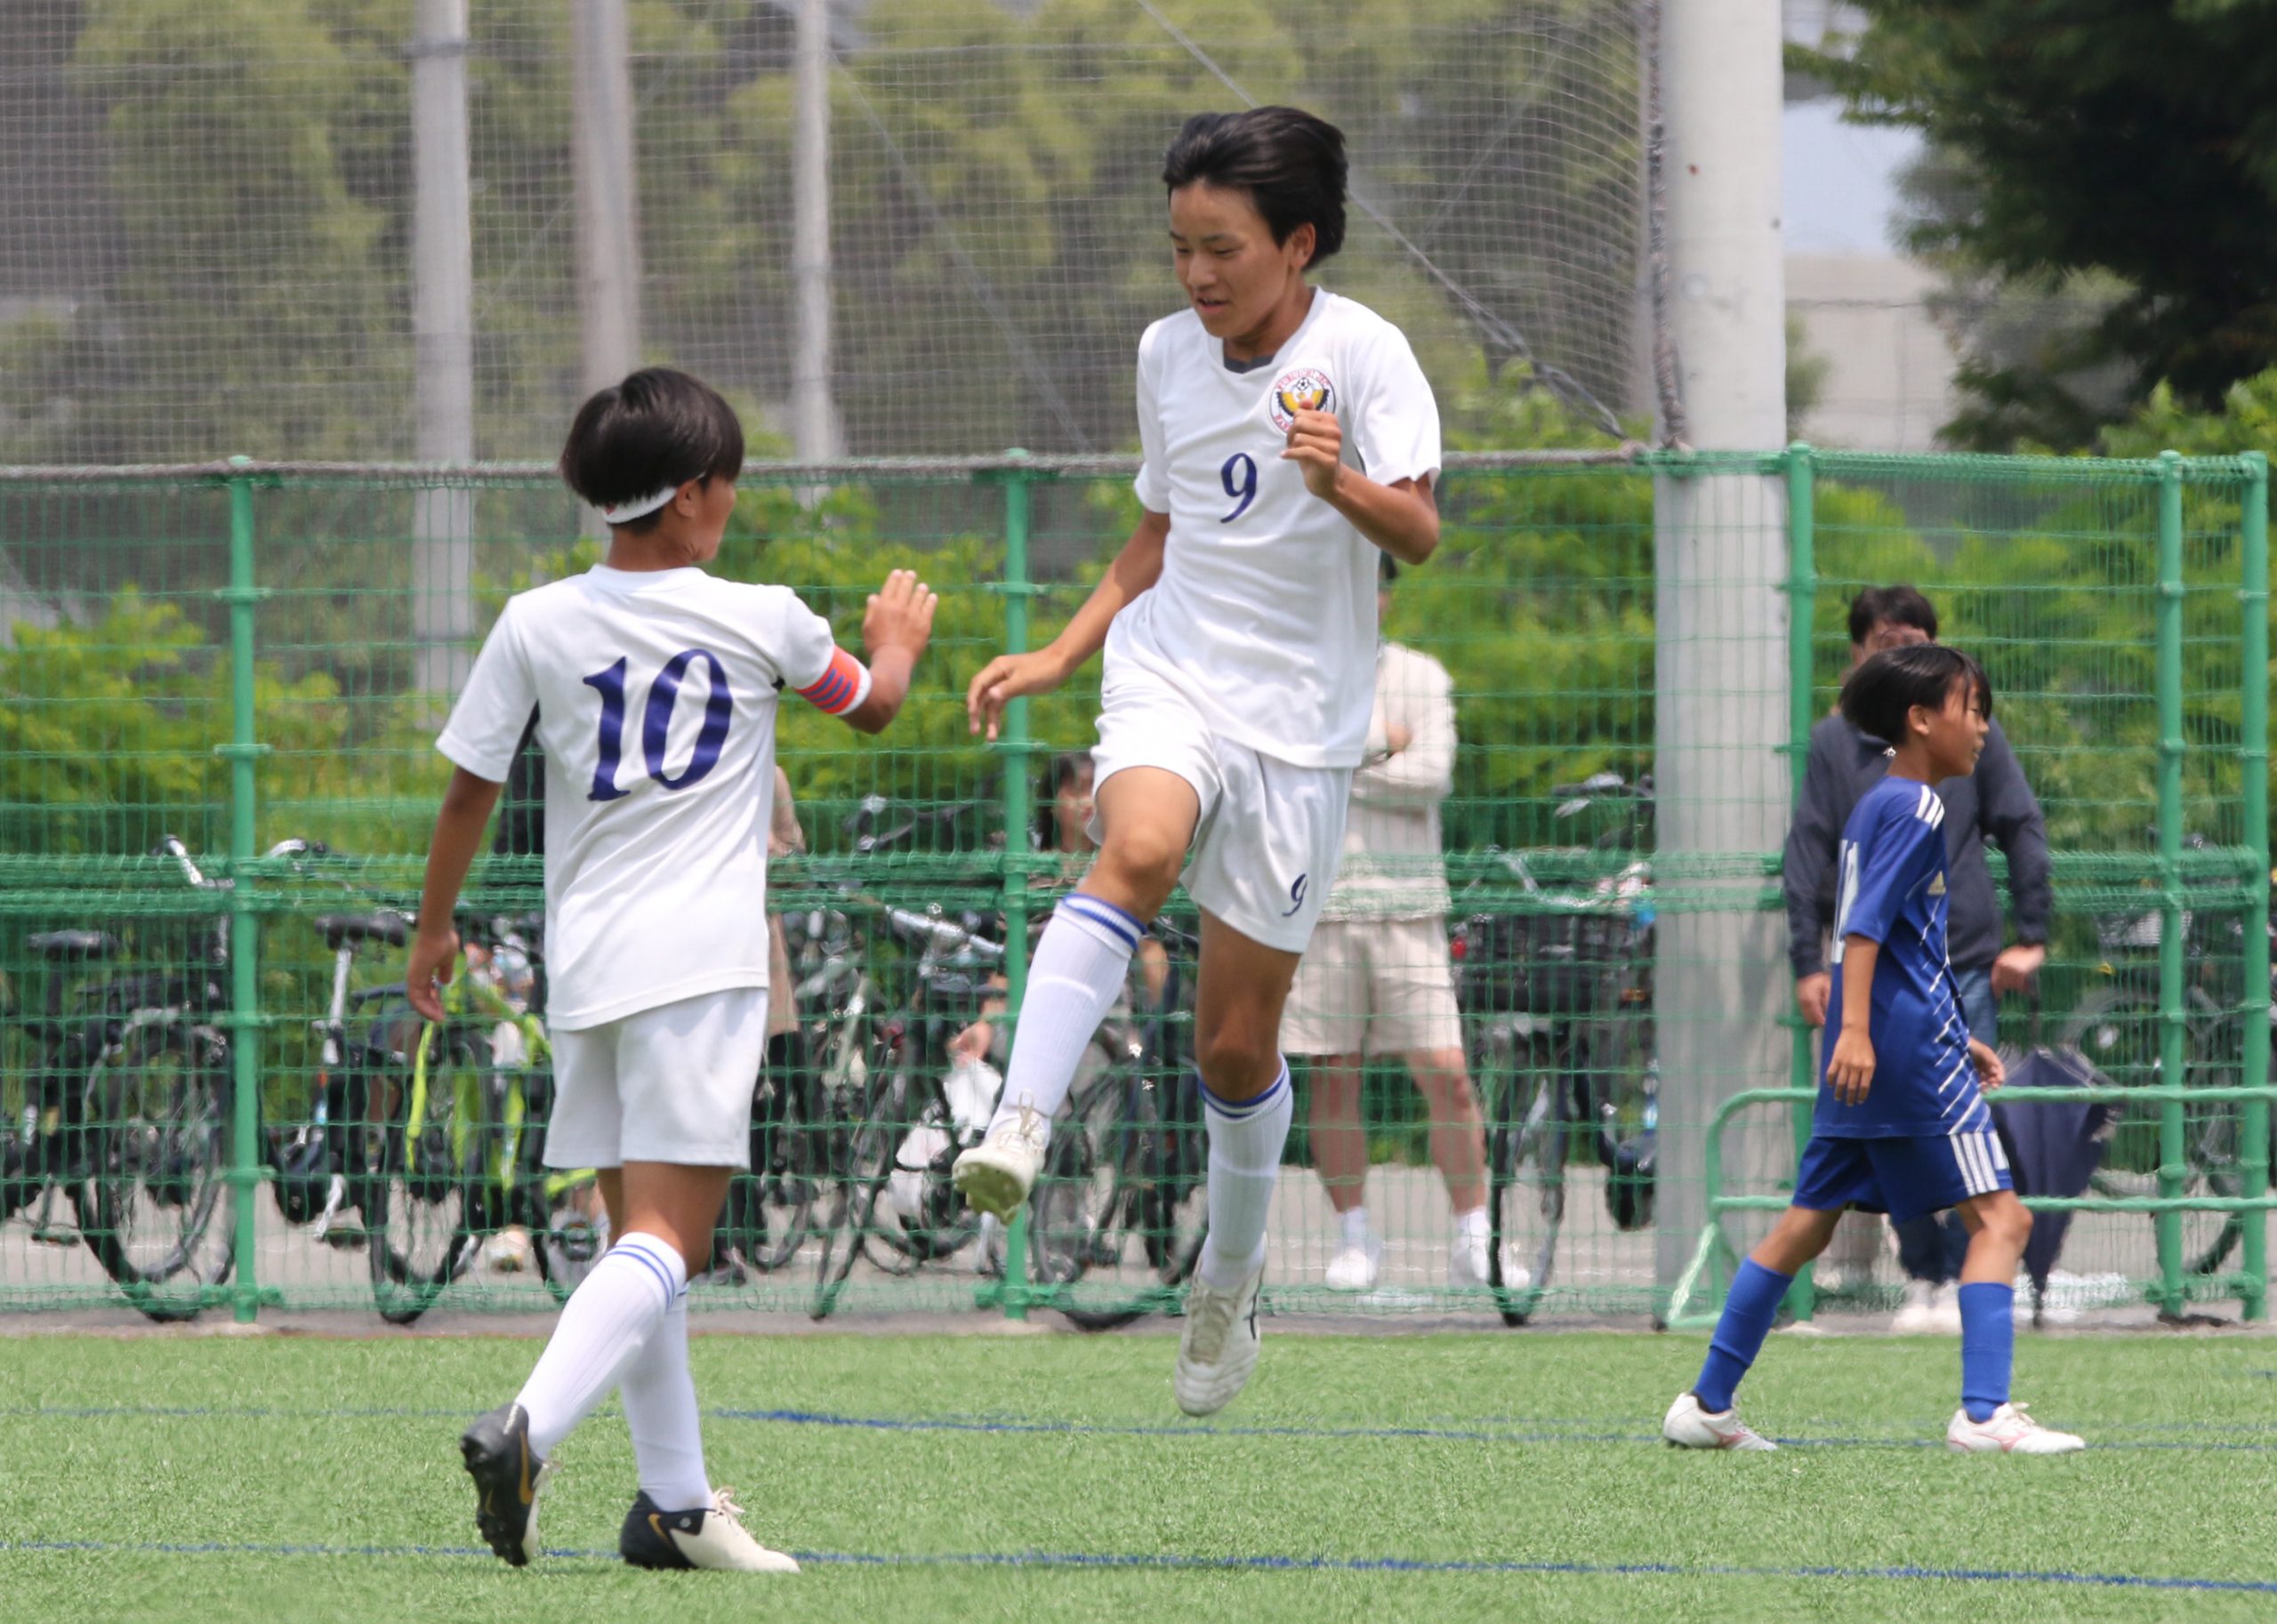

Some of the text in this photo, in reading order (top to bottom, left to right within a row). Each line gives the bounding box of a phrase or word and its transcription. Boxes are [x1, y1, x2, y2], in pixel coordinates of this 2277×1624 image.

[1220, 453, 1257, 524] 9
[583, 648, 733, 801] 10
[1282, 873, 1307, 917] 9
